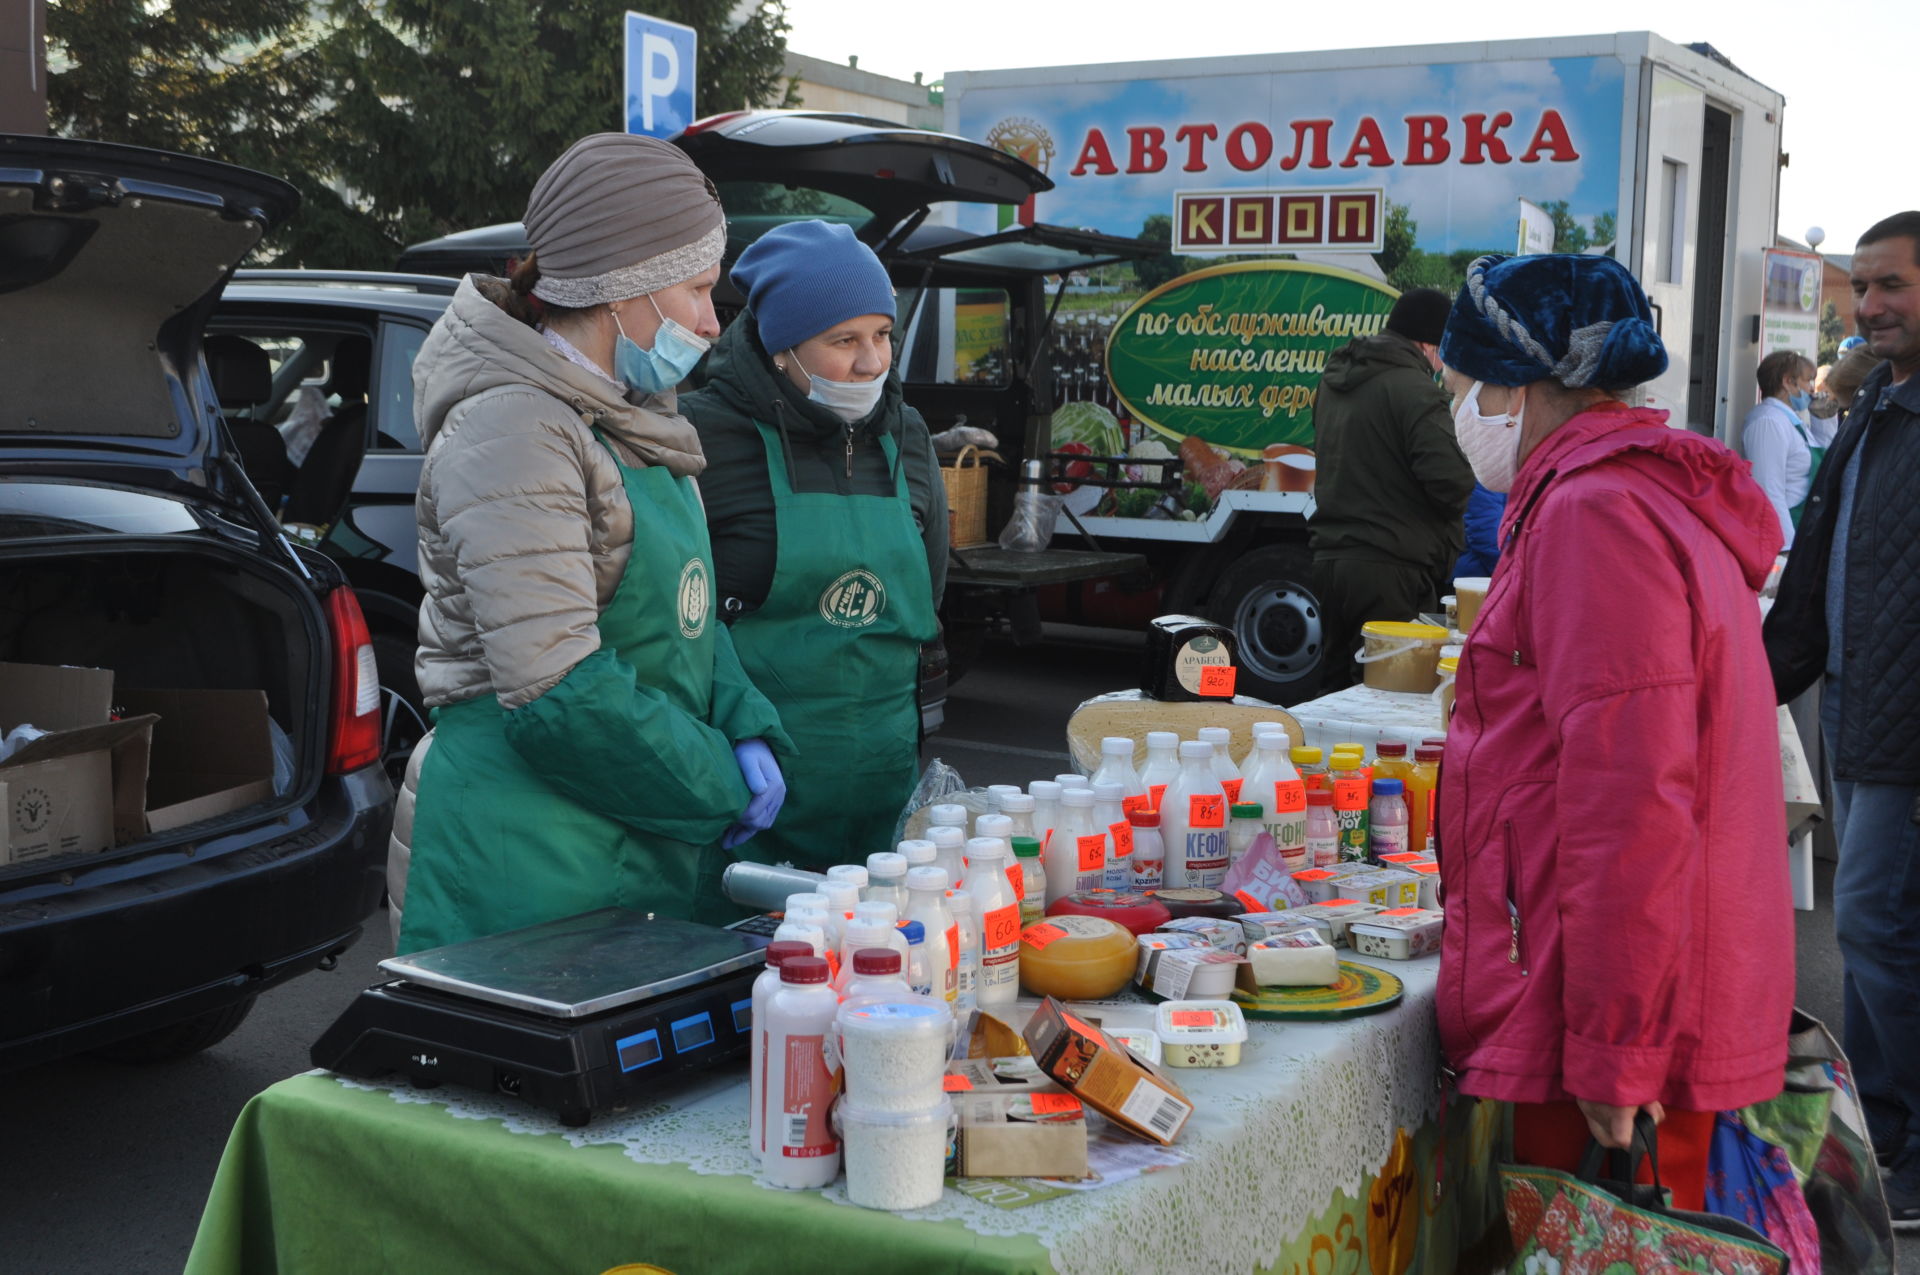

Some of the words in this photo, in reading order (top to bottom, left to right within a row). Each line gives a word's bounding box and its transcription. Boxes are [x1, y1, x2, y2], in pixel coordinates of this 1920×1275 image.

[642, 32, 679, 131] P
[1070, 109, 1580, 176] АВТОЛАВКА
[1188, 201, 1367, 239] КООП
[1136, 312, 1174, 335] по
[1176, 304, 1389, 345] обслуживани
[1190, 348, 1331, 373] населени
[1146, 384, 1254, 408] малых
[1183, 656, 1226, 665] АРАБЕСК
